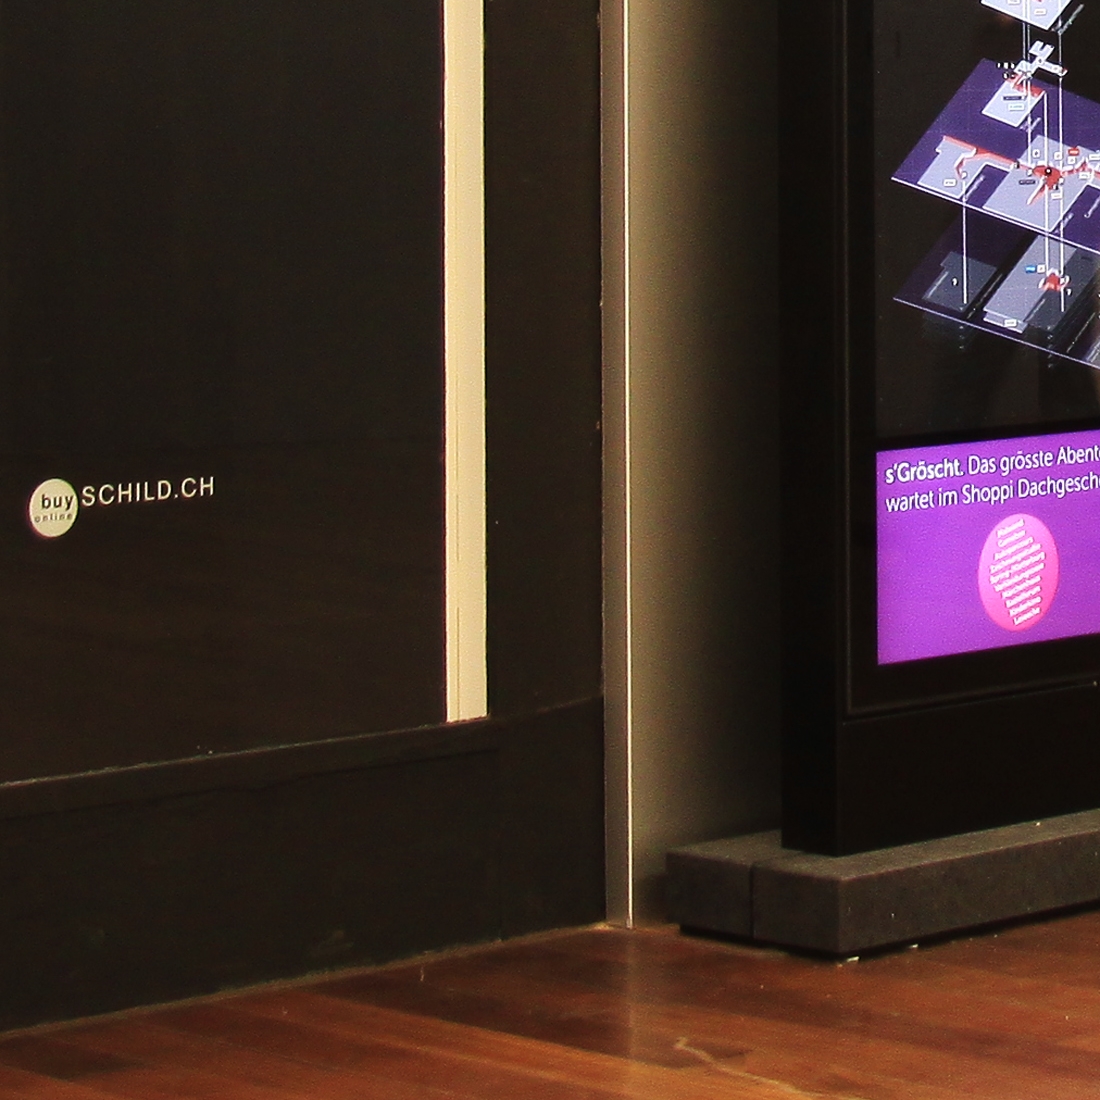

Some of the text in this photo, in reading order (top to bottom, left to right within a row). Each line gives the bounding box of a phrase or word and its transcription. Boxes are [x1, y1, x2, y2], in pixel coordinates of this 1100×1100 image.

[884, 459, 965, 484] s'Gröscht.
[967, 454, 998, 476] Das
[1000, 450, 1054, 476] grösste
[41, 493, 74, 511] buy
[81, 475, 215, 507] SCHILD.CH
[885, 490, 936, 513] wartet
[938, 487, 959, 506] im
[961, 479, 1015, 506] Shoppi
[34, 512, 73, 524] online
